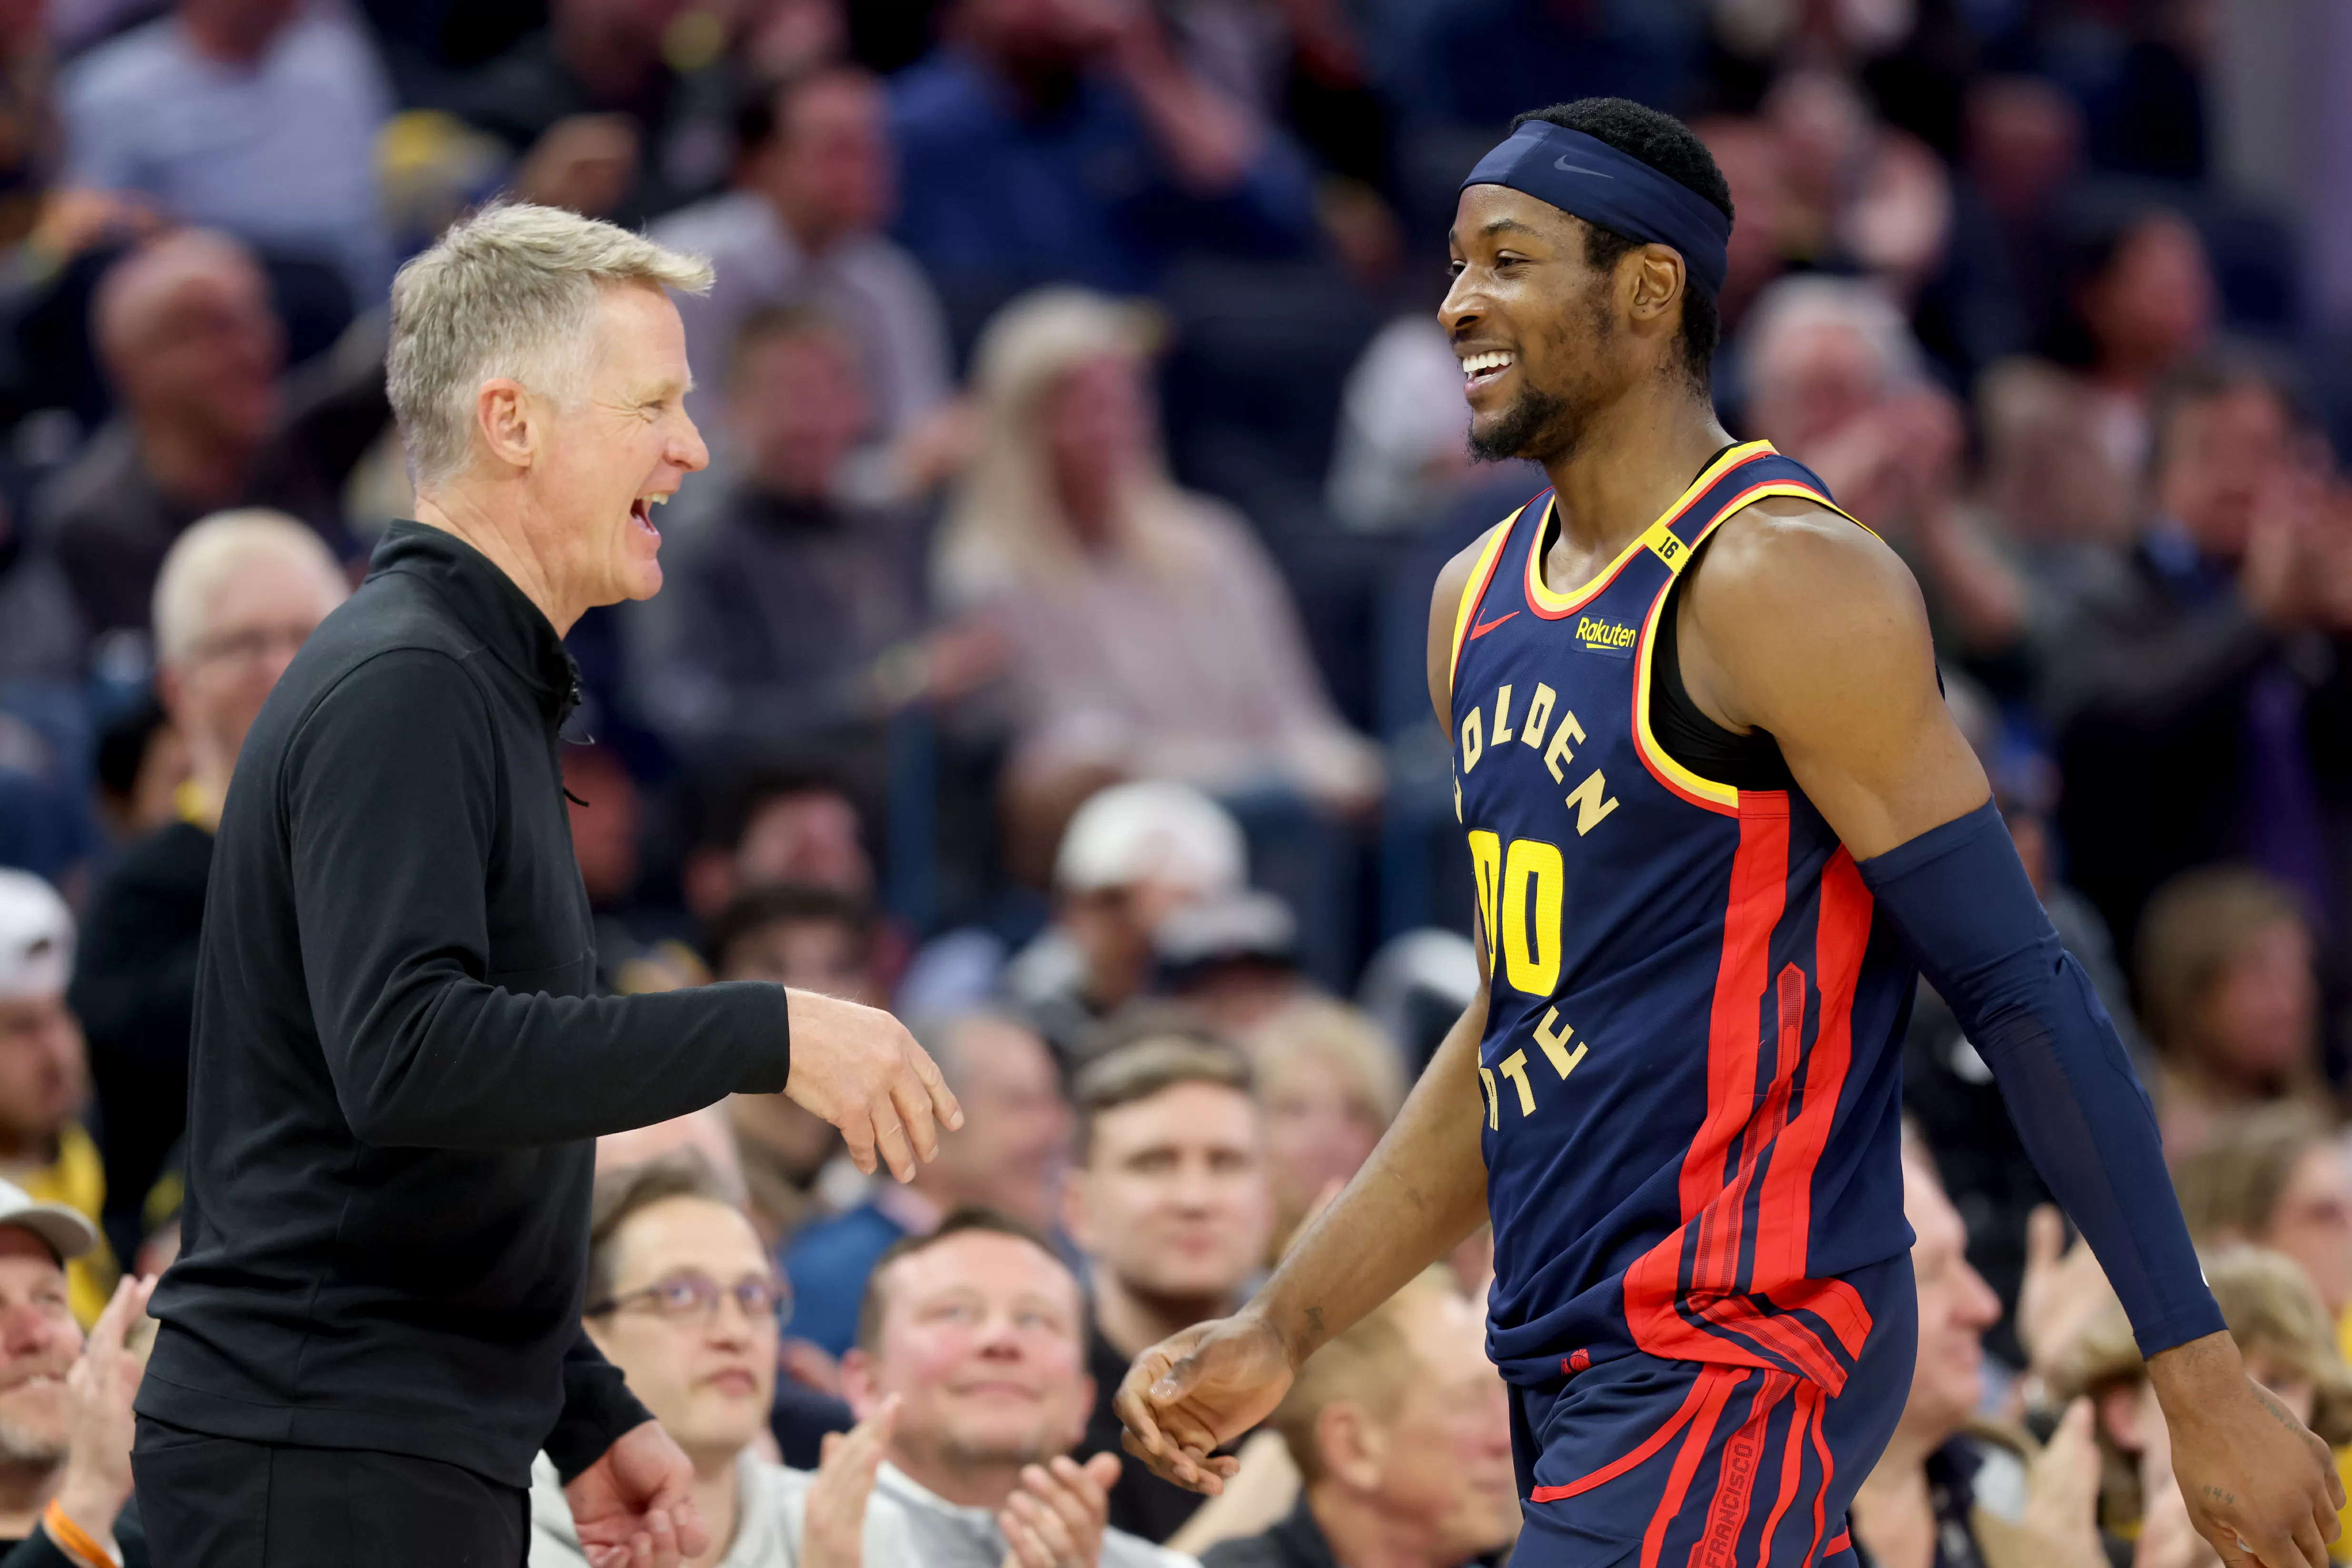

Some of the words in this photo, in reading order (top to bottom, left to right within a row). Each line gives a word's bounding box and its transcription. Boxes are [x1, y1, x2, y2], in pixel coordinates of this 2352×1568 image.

[1658, 536, 1679, 559] 16
[1575, 617, 1636, 647] Rakuten
[1468, 829, 1563, 997] 00
[1705, 1443, 1753, 1568] FRANCISCO
